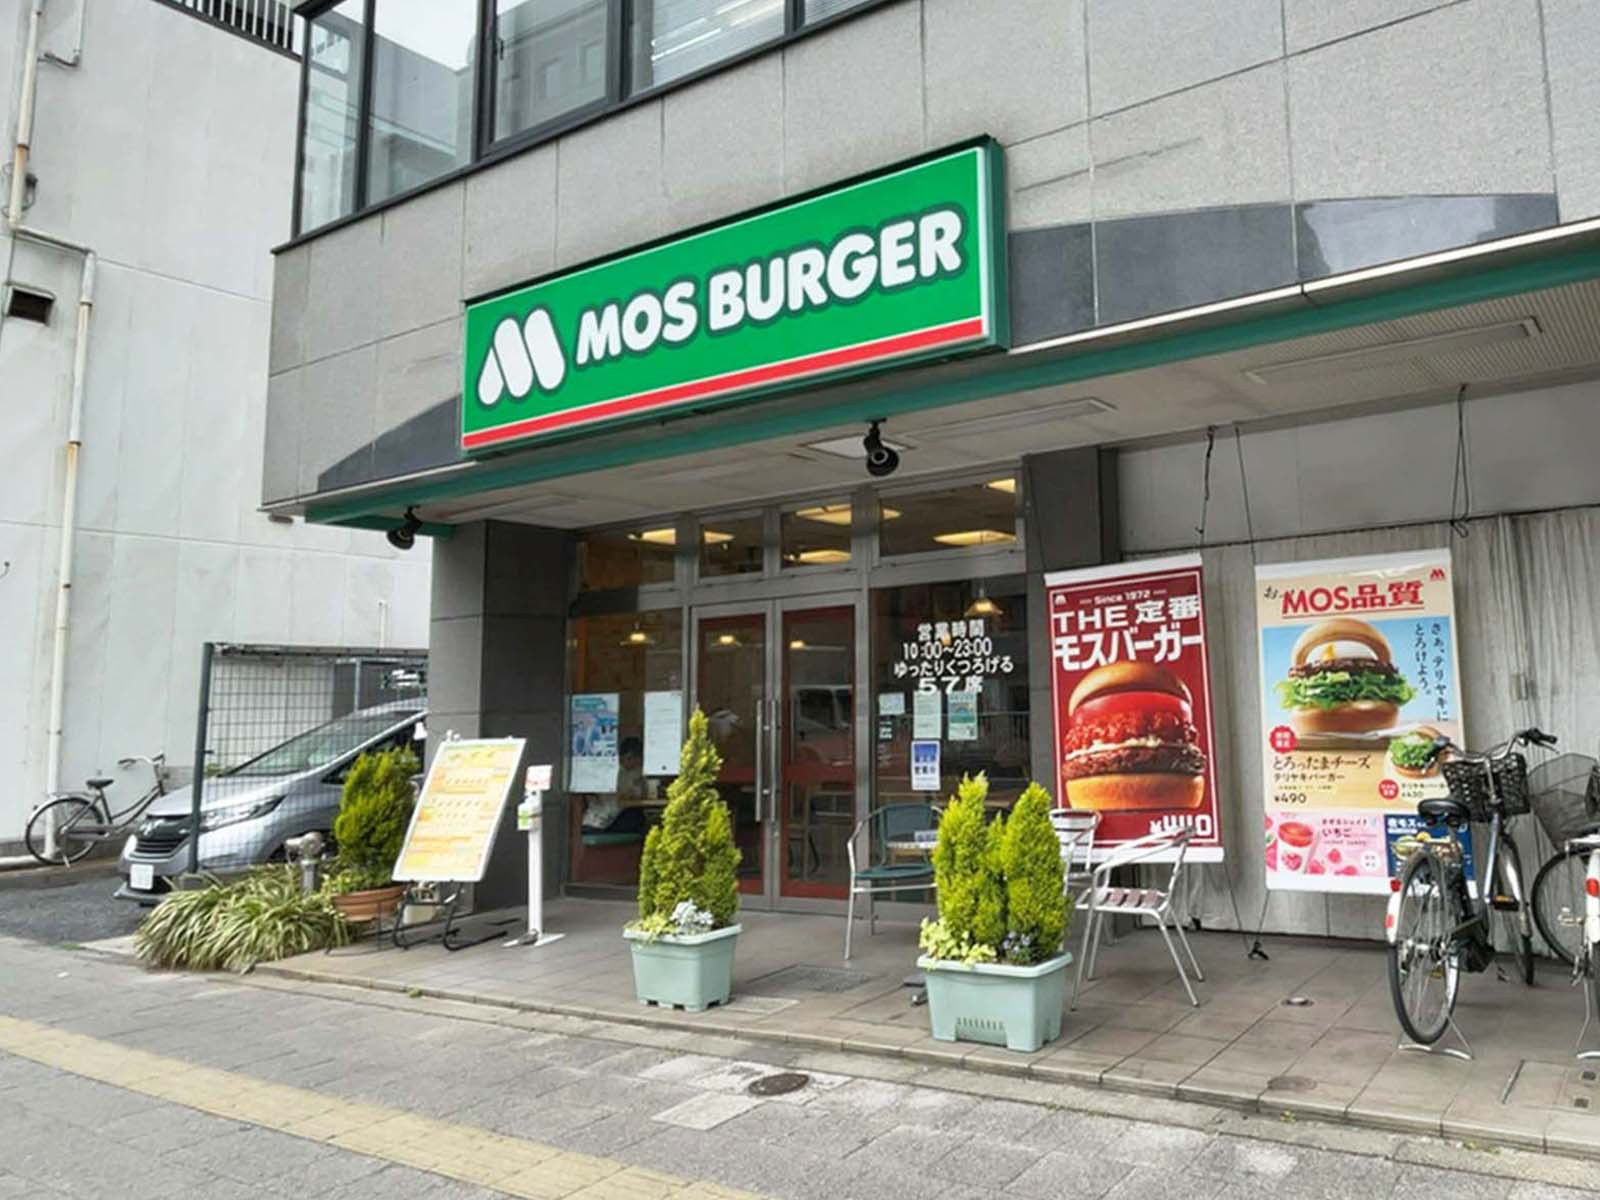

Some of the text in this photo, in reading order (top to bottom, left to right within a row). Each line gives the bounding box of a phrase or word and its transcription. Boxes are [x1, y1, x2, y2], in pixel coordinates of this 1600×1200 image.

[575, 209, 963, 366] MOS BURGER
[1094, 590, 1151, 605] Since 1972
[1052, 594, 1201, 633] THE 定番
[917, 619, 985, 642] 営業時間
[1053, 622, 1204, 672] モスバーガー
[893, 655, 1014, 679] ゆったりくつろげる
